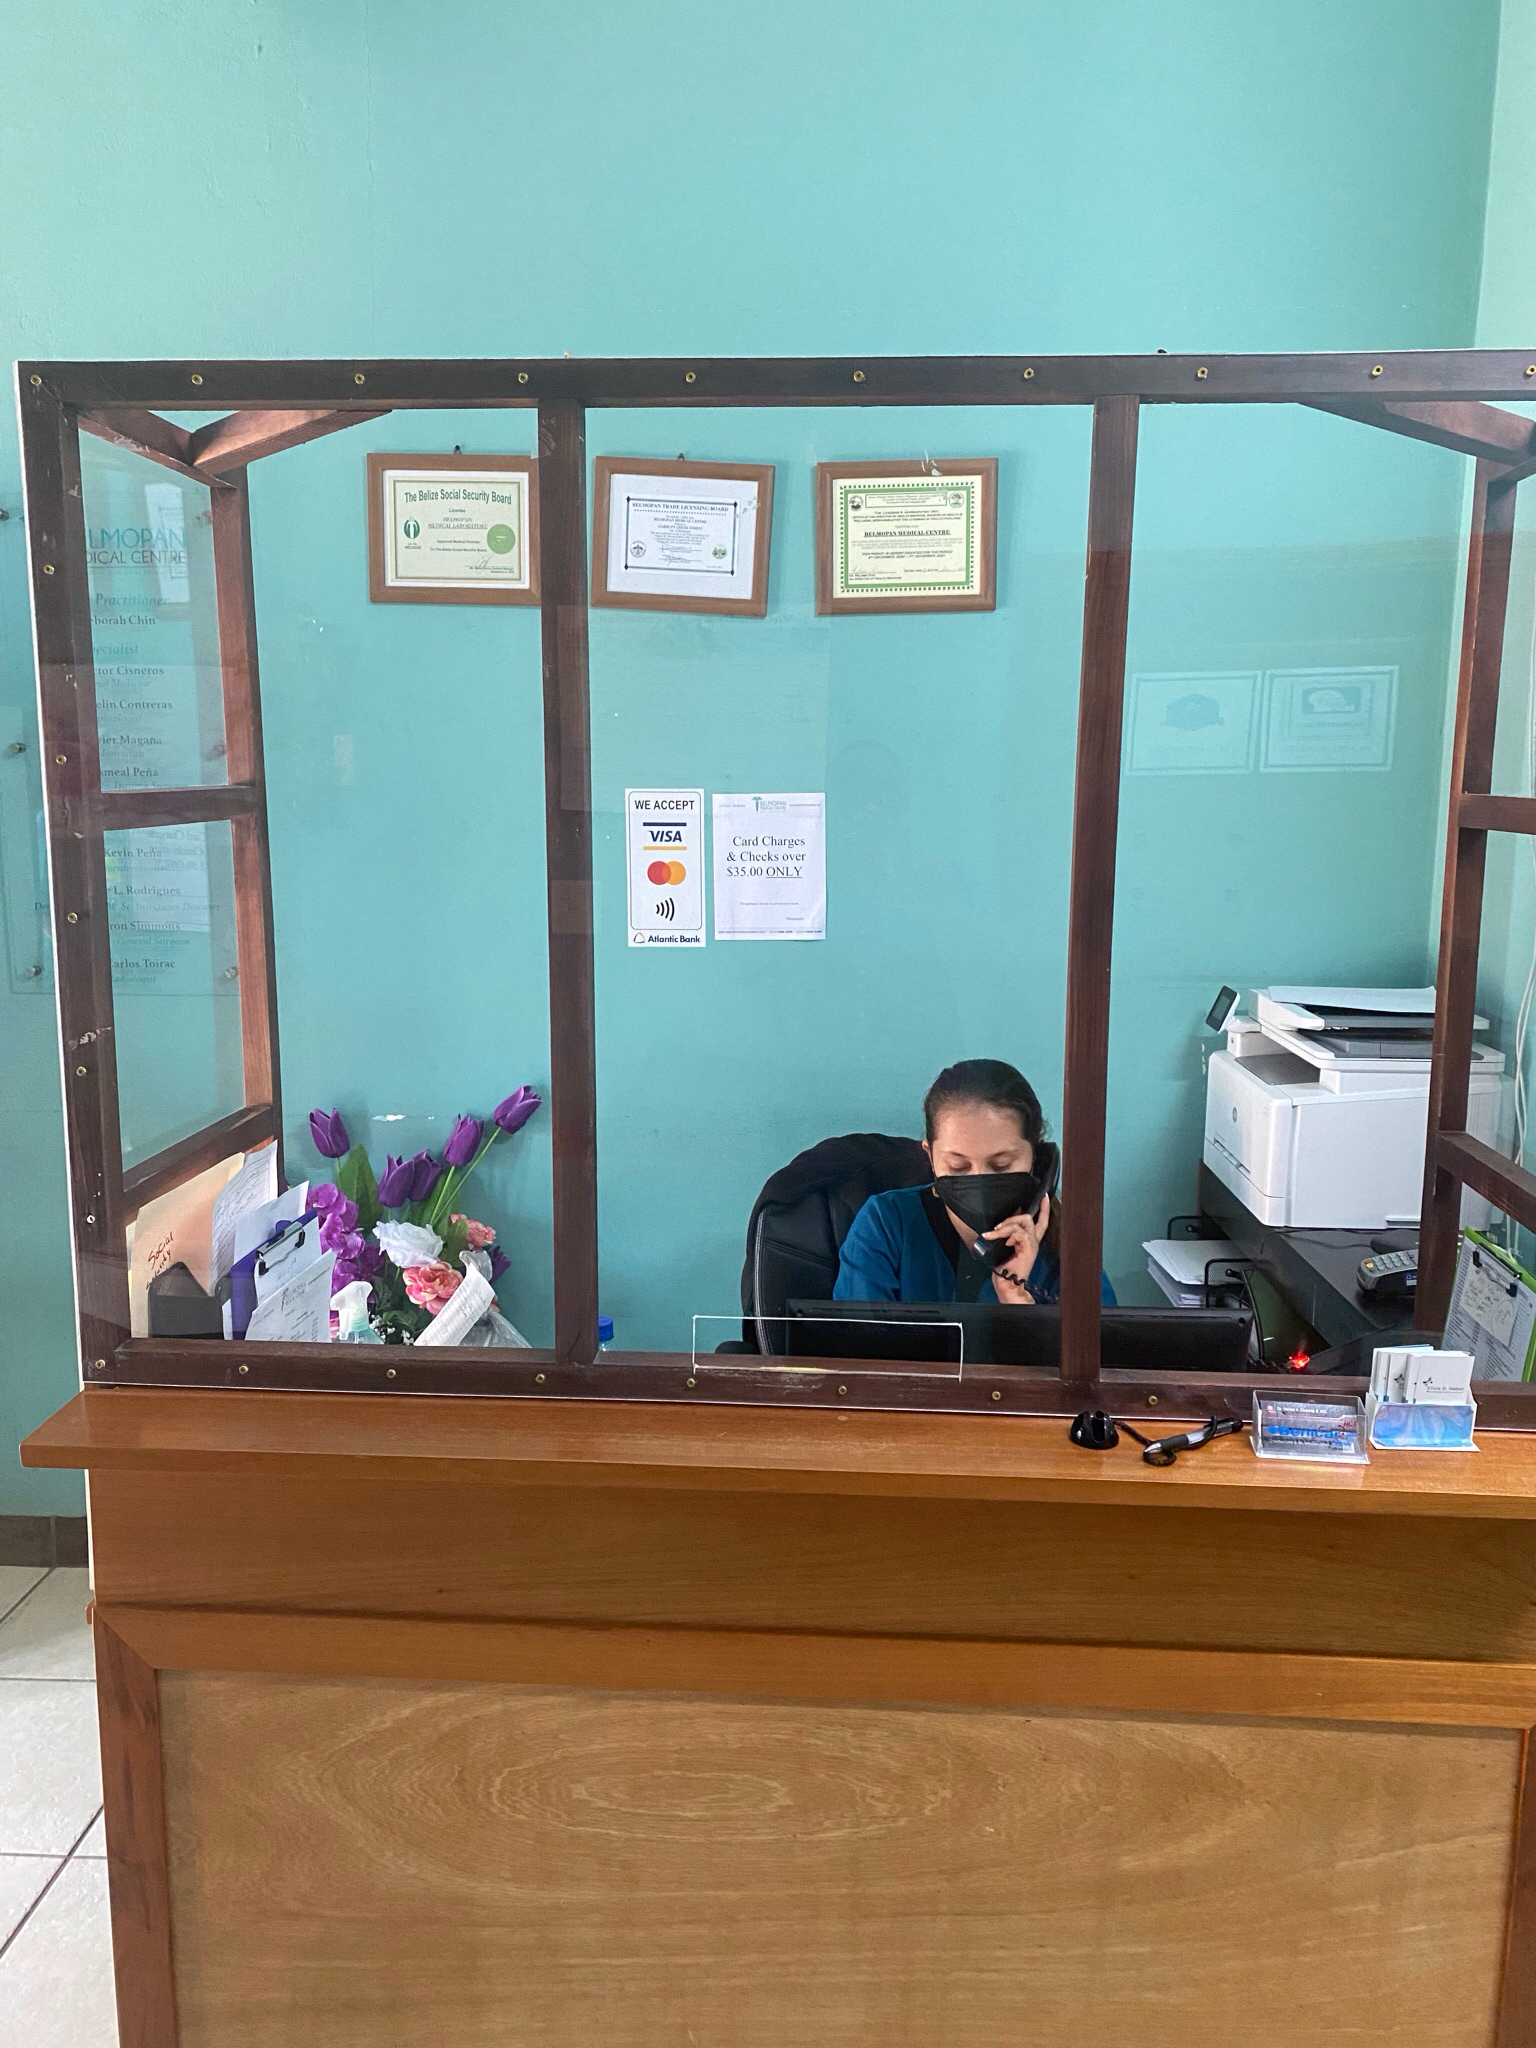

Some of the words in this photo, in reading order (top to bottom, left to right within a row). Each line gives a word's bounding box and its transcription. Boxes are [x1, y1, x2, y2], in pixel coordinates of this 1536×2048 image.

[405, 492, 417, 503] The
[418, 490, 439, 501] Belize
[440, 488, 461, 500] Social
[462, 489, 489, 504] Security
[491, 491, 512, 505] Board
[89, 528, 185, 549] LMOPAN
[87, 550, 126, 564] DICAL
[131, 550, 186, 564] CENTRE
[91, 615, 126, 625] borah
[128, 615, 156, 625] Chin
[94, 643, 139, 655] ecialist
[117, 665, 165, 675] Cisneros
[96, 699, 117, 709] elin
[119, 699, 173, 709] Contreras
[133, 767, 159, 777] Peña
[634, 800, 651, 810] WE
[653, 800, 695, 810] ACCEPT
[648, 830, 683, 843] VISA
[732, 836, 759, 847] Card
[761, 836, 806, 848] Charges
[726, 851, 736, 861] &
[740, 851, 779, 861] Checks
[782, 853, 806, 861] over
[726, 866, 763, 877] $35.00
[766, 866, 803, 877] ONLY
[126, 886, 181, 897] Rodriguez
[130, 921, 180, 930] Simmons
[647, 935, 679, 943] Atlantic
[680, 935, 701, 943] Bank
[112, 959, 140, 968] arlos
[142, 959, 176, 968] Toirac
[113, 974, 157, 984] adiologist
[148, 1231, 174, 1270] Social
